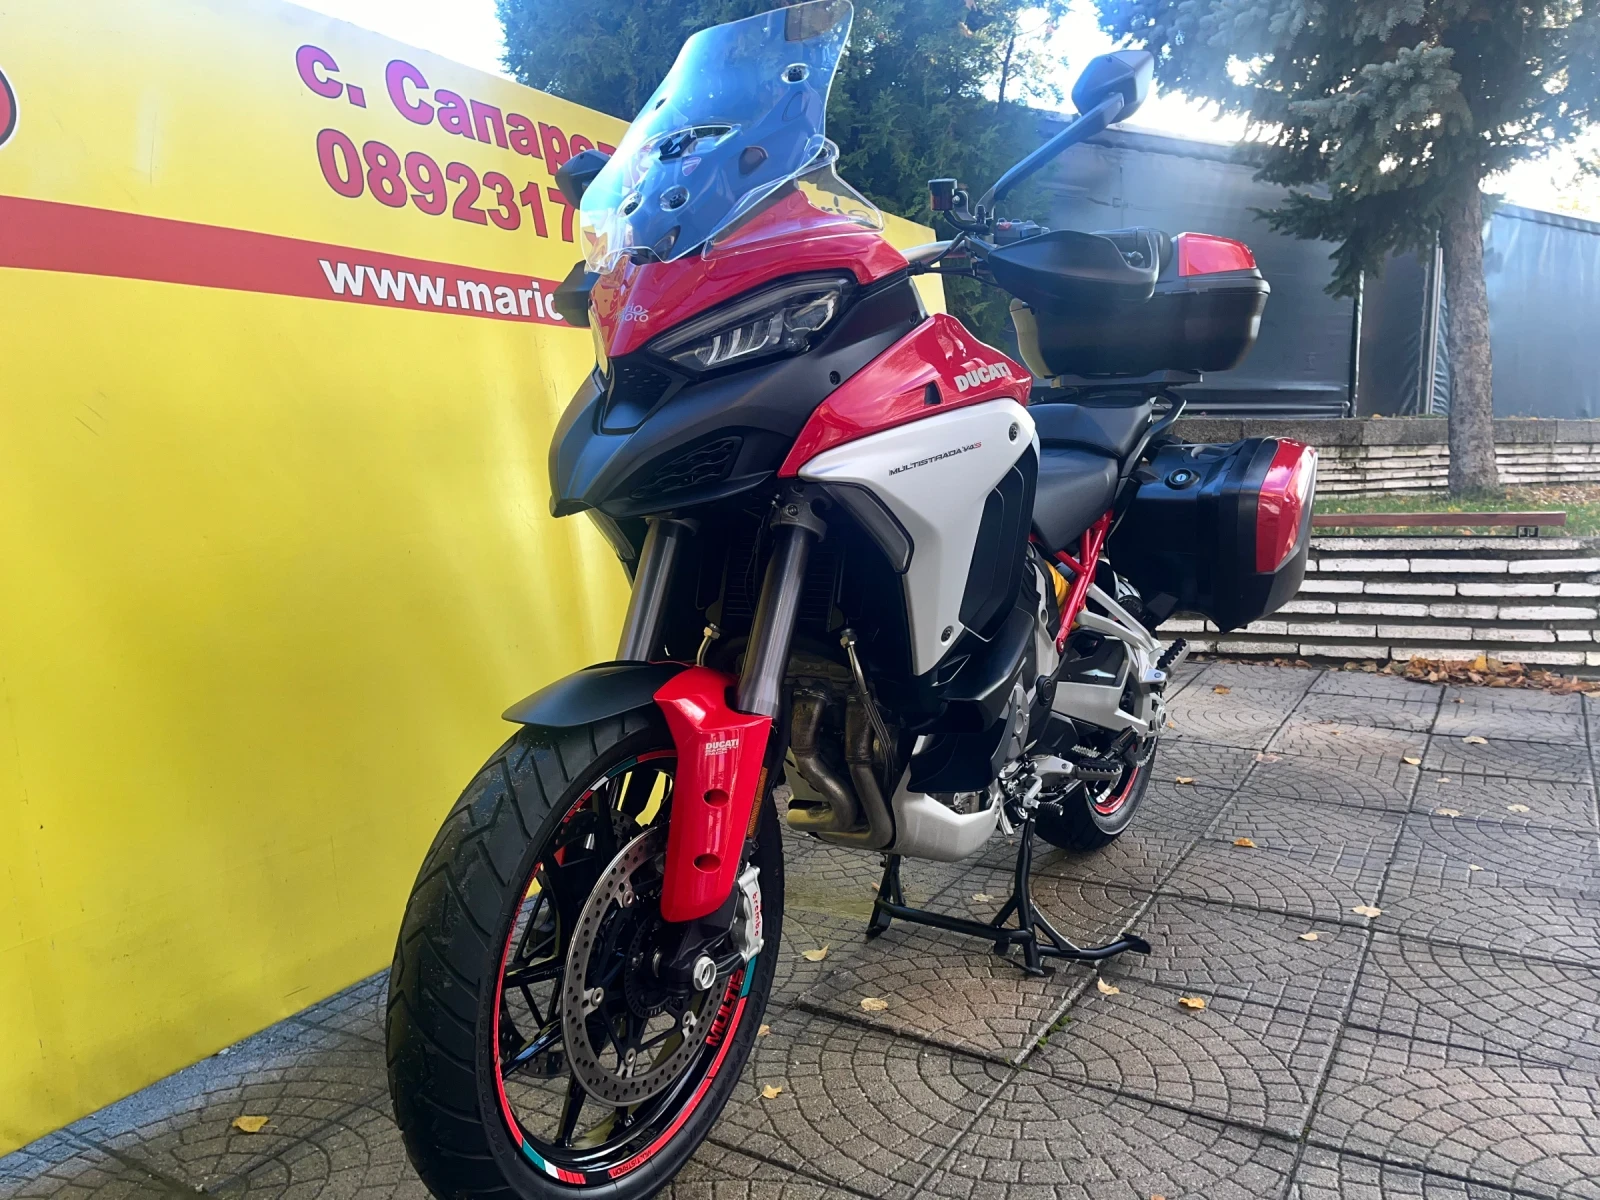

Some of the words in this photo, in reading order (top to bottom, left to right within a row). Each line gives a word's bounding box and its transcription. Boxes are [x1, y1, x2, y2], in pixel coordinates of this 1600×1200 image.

[385, 59, 617, 177] Сапар
[953, 362, 1012, 393] DUCATI
[888, 448, 963, 476] MULTISTRADA
[705, 738, 739, 750] DUCATI
[752, 891, 761, 937] brembo
